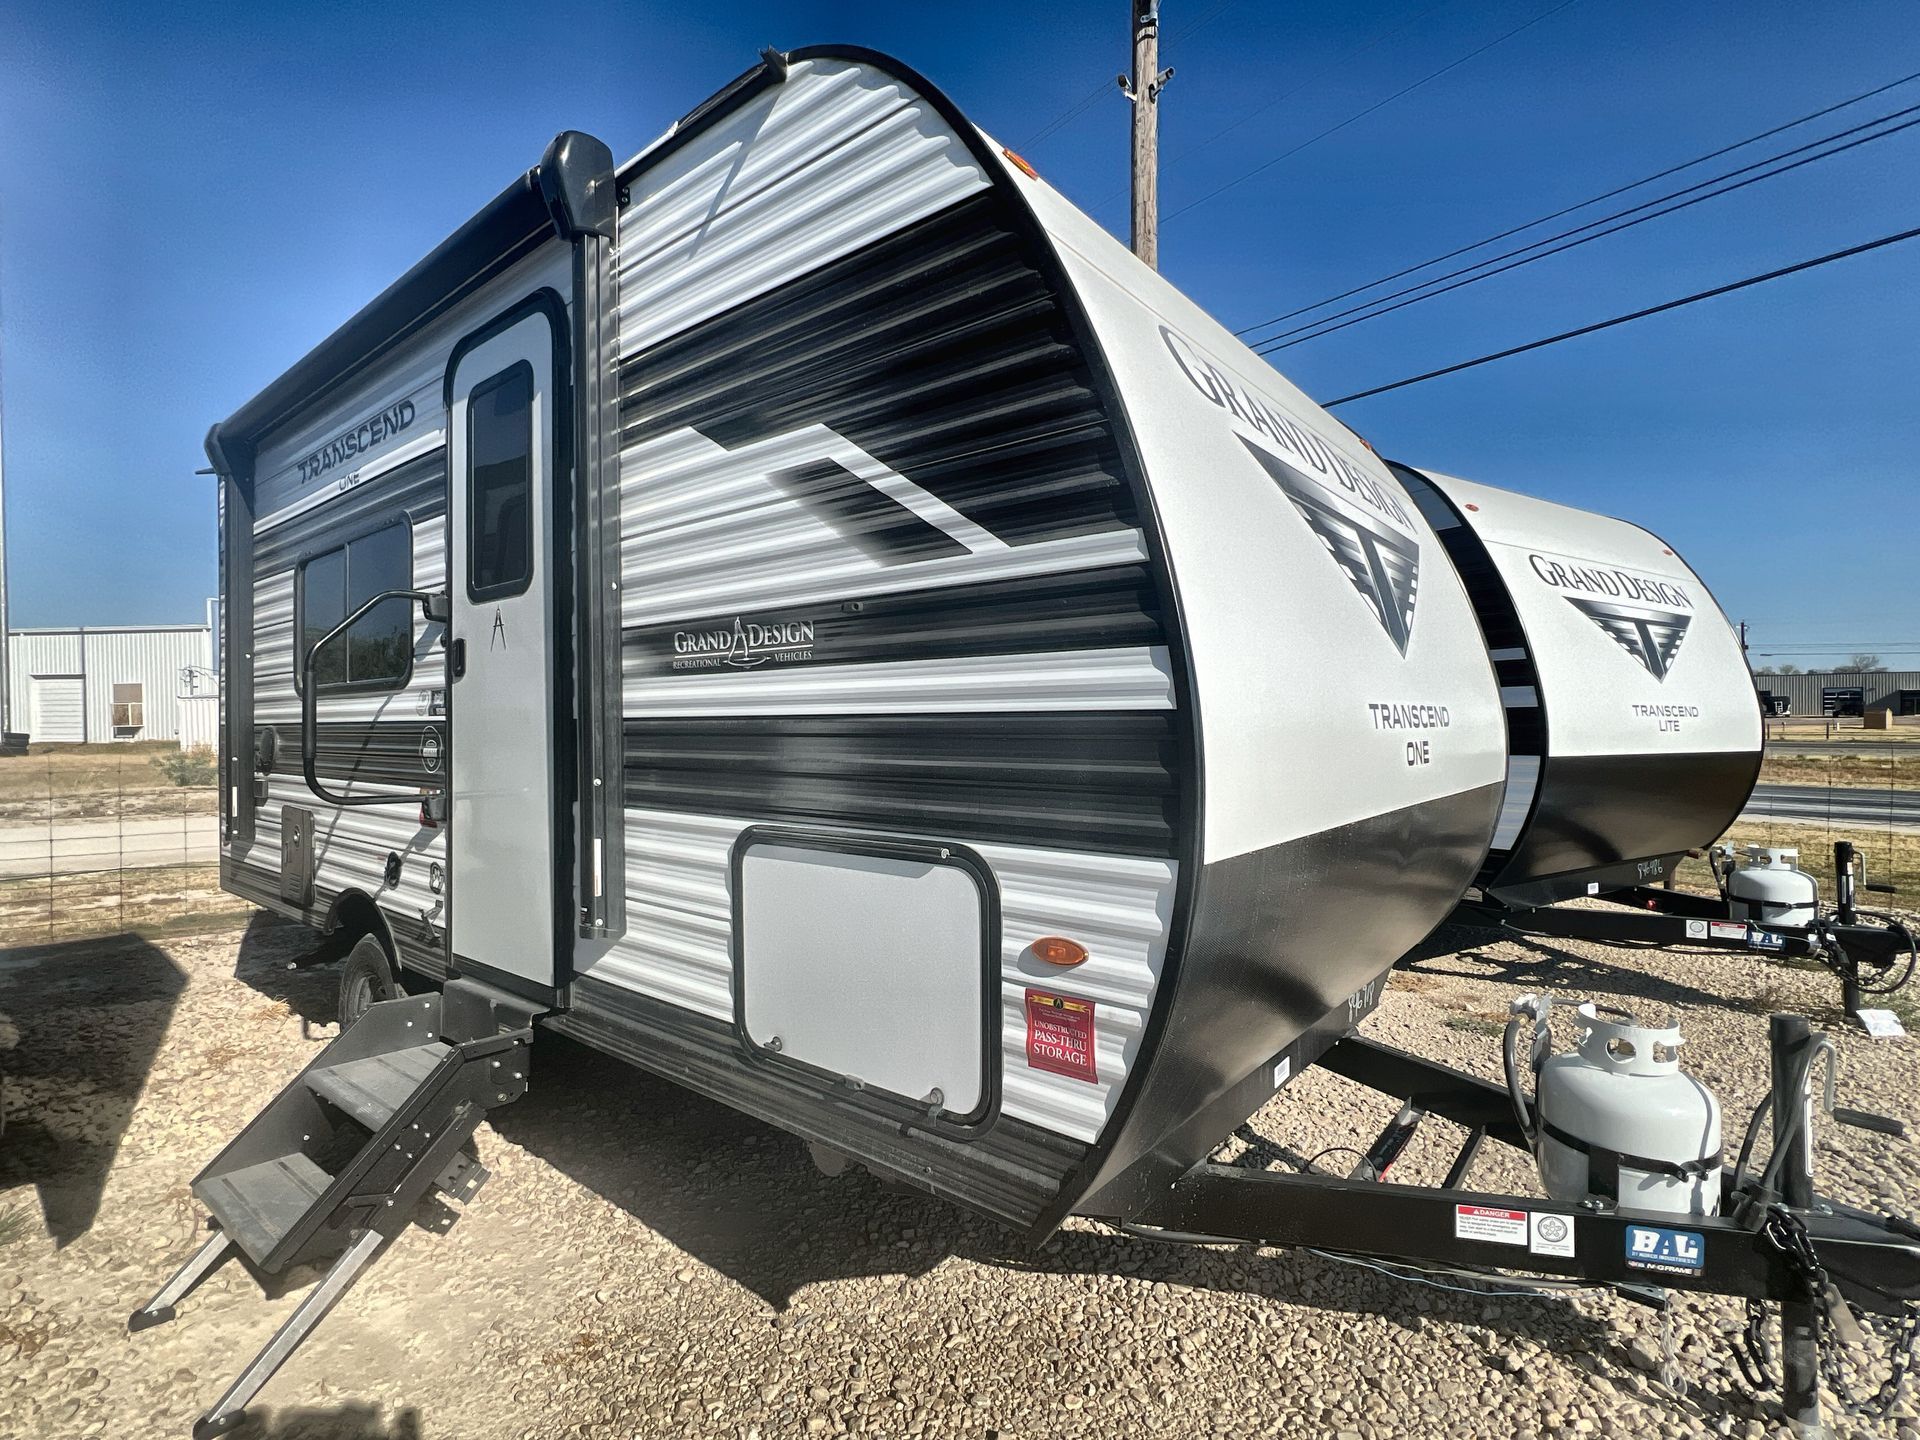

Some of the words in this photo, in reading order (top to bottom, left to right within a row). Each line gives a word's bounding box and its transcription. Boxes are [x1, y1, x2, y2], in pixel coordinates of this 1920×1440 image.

[297, 399, 415, 485] TRANSCEND
[1158, 324, 1327, 475] GRAND
[1306, 428, 1419, 535] DESIGN
[1528, 553, 1620, 597] GRAND
[1610, 569, 1695, 609] DESIGN
[673, 630, 731, 653] GRAND
[746, 620, 814, 647] DESIGN
[672, 657, 721, 669] RECREATIONAL
[774, 650, 812, 662] VEHICLES
[1368, 703, 1450, 729] TRANSCEND
[1632, 704, 1699, 718] TRANSCEND
[1658, 719, 1681, 732] LITE
[1406, 740, 1430, 766] ONE
[1034, 1020, 1087, 1040] UNOBSTRUCTED
[1034, 1029, 1087, 1052] PASS-THRU
[1033, 1042, 1088, 1066] STORAGE
[1479, 1208, 1510, 1219] DANGER
[1632, 1229, 1699, 1259] BAL
